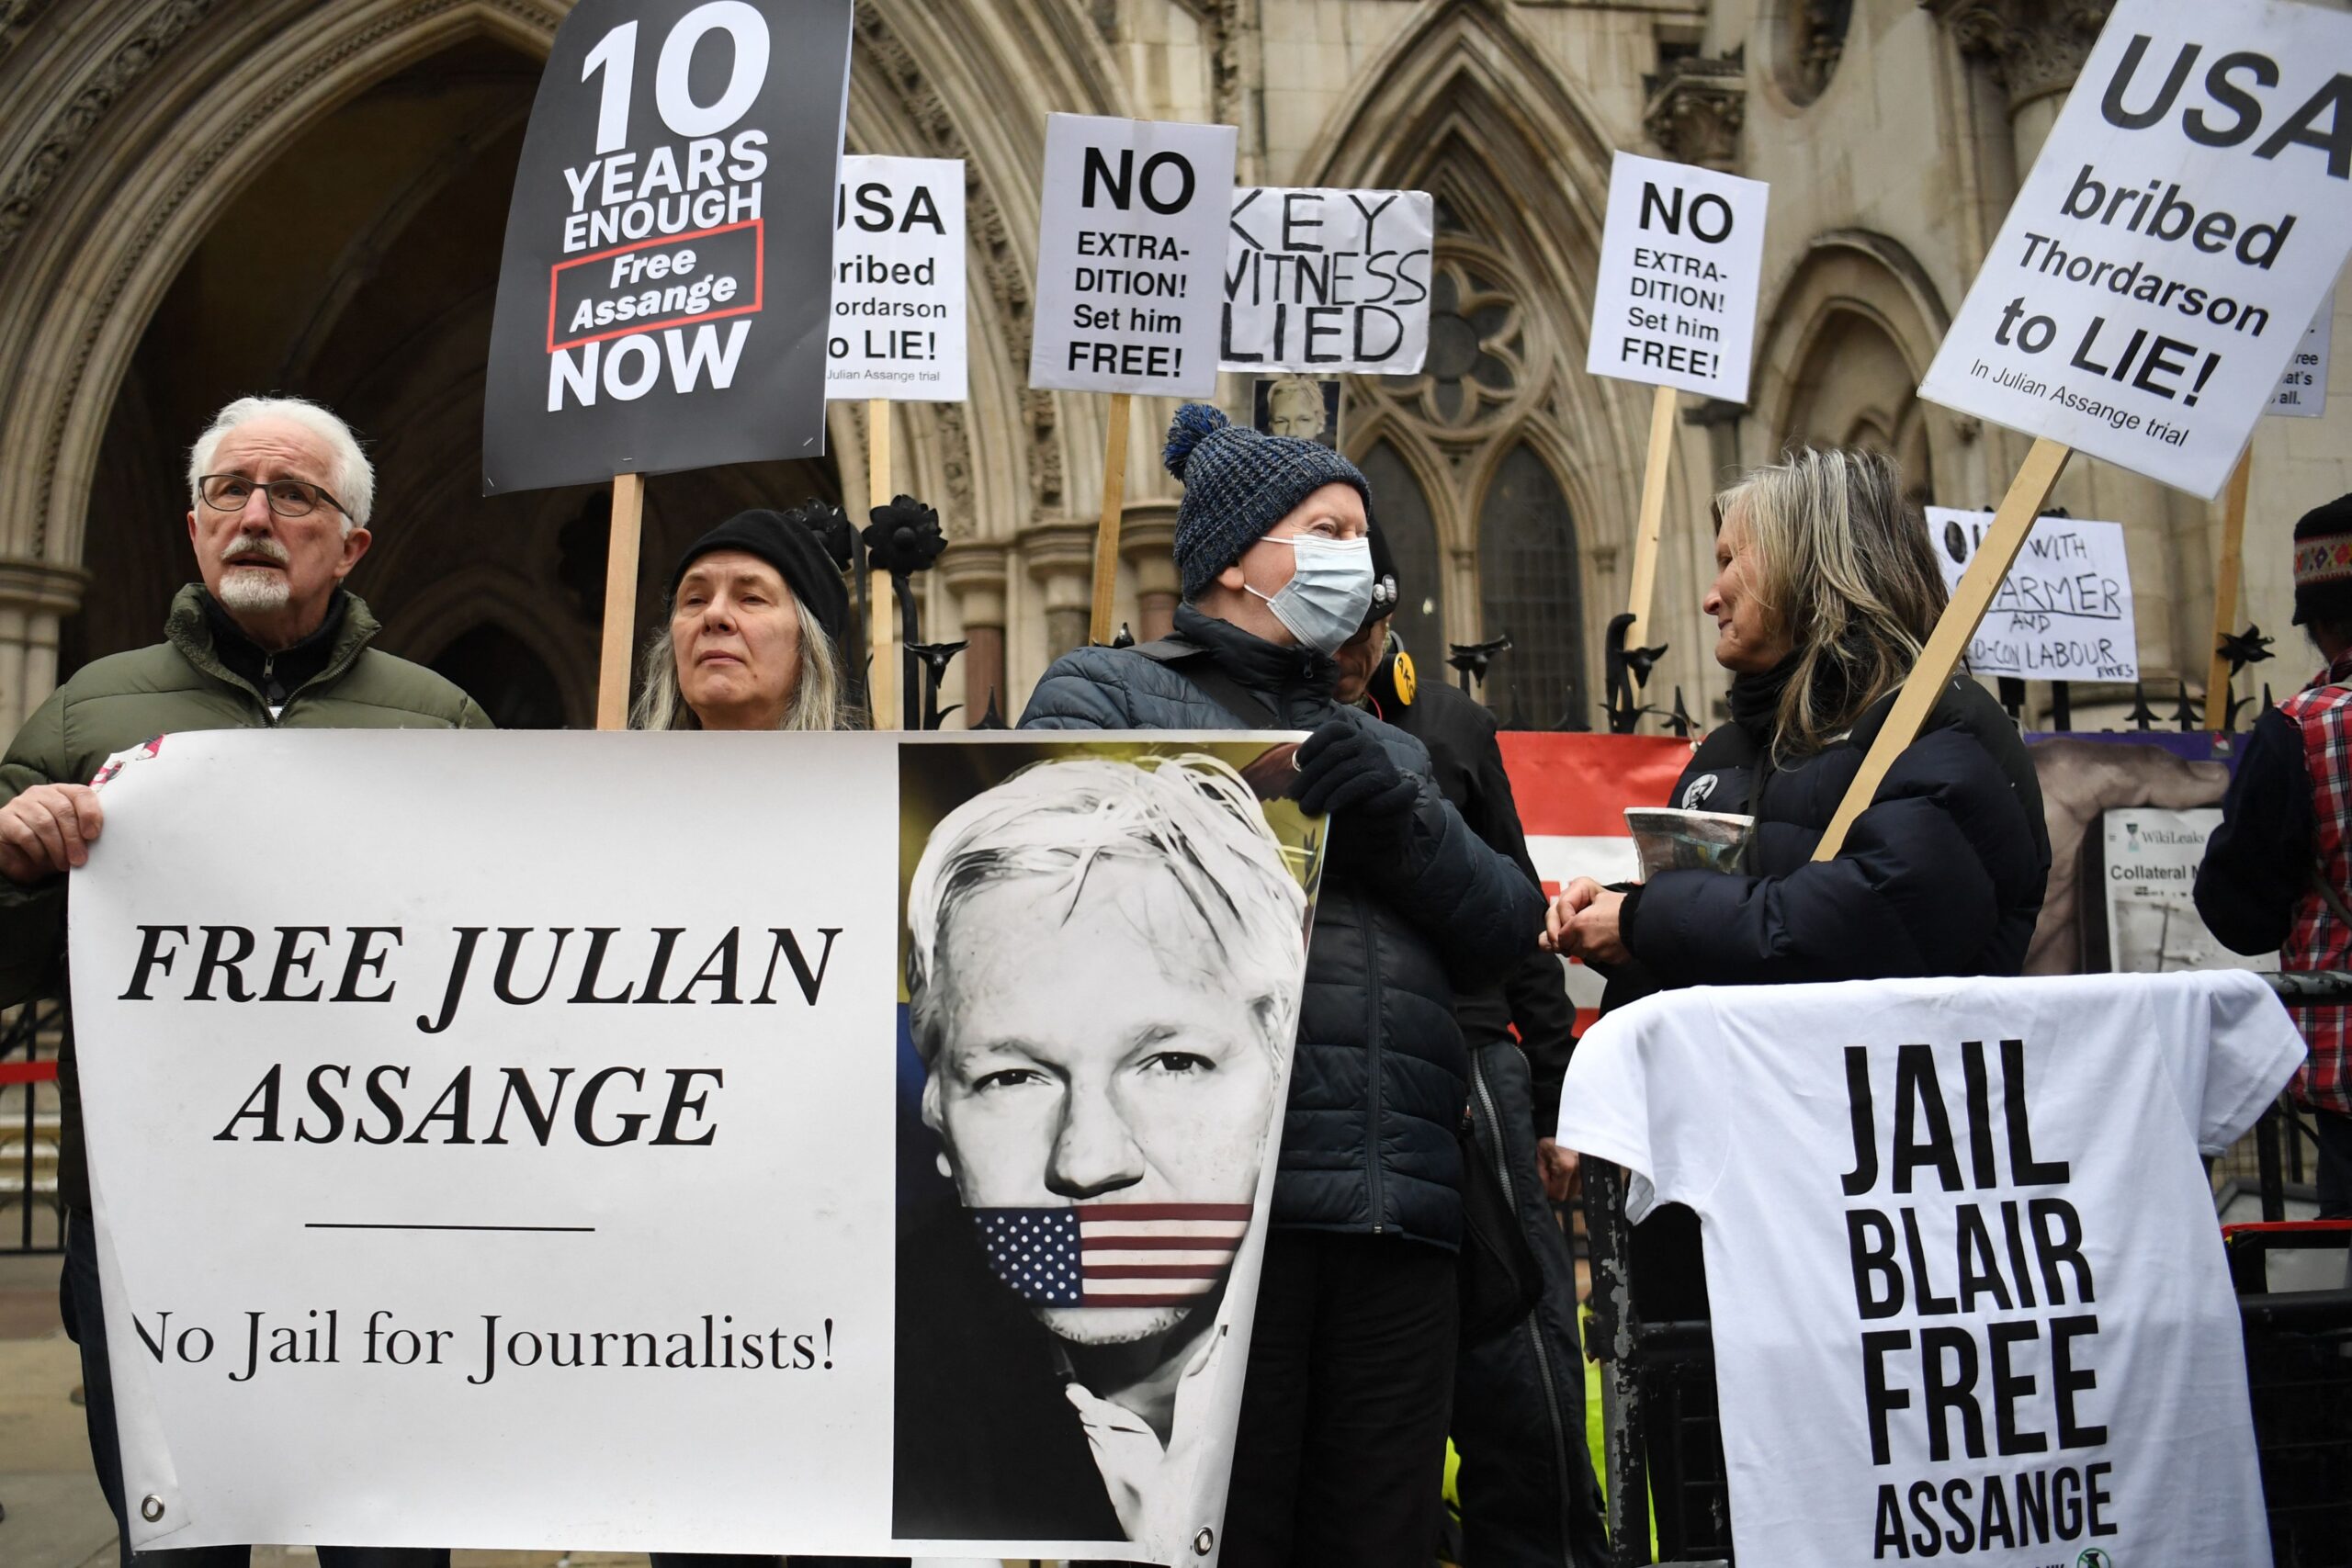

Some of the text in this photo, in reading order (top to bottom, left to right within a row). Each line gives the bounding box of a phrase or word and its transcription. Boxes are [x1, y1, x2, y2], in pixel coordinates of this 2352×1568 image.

[582, 0, 770, 155] 10
[2100, 34, 2352, 181] USA
[563, 130, 769, 213] YEARS
[1081, 147, 1195, 215] NO
[563, 182, 763, 254] ENOUGH
[1639, 182, 1733, 244] NO
[2060, 164, 2296, 270] bribed
[1078, 231, 1190, 261] EXTRA-
[1634, 248, 1728, 282] EXTRA-
[610, 249, 696, 289] Free
[834, 254, 935, 286] ribed
[1075, 267, 1187, 299] DITION!
[2019, 232, 2269, 337] Thordarson
[569, 274, 738, 333] Assange
[835, 298, 947, 319] ordarson
[1630, 277, 1724, 312] DITION!
[1073, 304, 1182, 333] Set him
[1220, 303, 1404, 363] LIED
[1628, 307, 1720, 343] Set him
[548, 320, 752, 412] NOW
[828, 330, 936, 360] o LIE!
[1068, 341, 1183, 378] FREE!
[1621, 337, 1720, 379] FREE!
[1994, 296, 2222, 407] to LIE!
[2295, 354, 2319, 366] ree
[827, 368, 940, 383] Julian Assange trial
[2284, 371, 2312, 386] at's
[1971, 358, 2190, 447] In Julian Assange trial
[2029, 533, 2087, 561] WITH
[1996, 572, 2122, 614] ARMER
[2009, 612, 2052, 634] AND
[2025, 638, 2117, 670] LABOUR
[2142, 830, 2205, 844] WikiLeaks
[2110, 864, 2187, 880] Collateral
[118, 924, 843, 1034] FREE JULIAN
[213, 1063, 724, 1147] ASSANGE
[1840, 1039, 2071, 1196] JAIL
[1845, 1197, 2096, 1320] BLAIR
[131, 1308, 835, 1385] No Jail for Journalists!
[1860, 1314, 2109, 1466] FREE
[1873, 1461, 2119, 1560] ASSANGE
